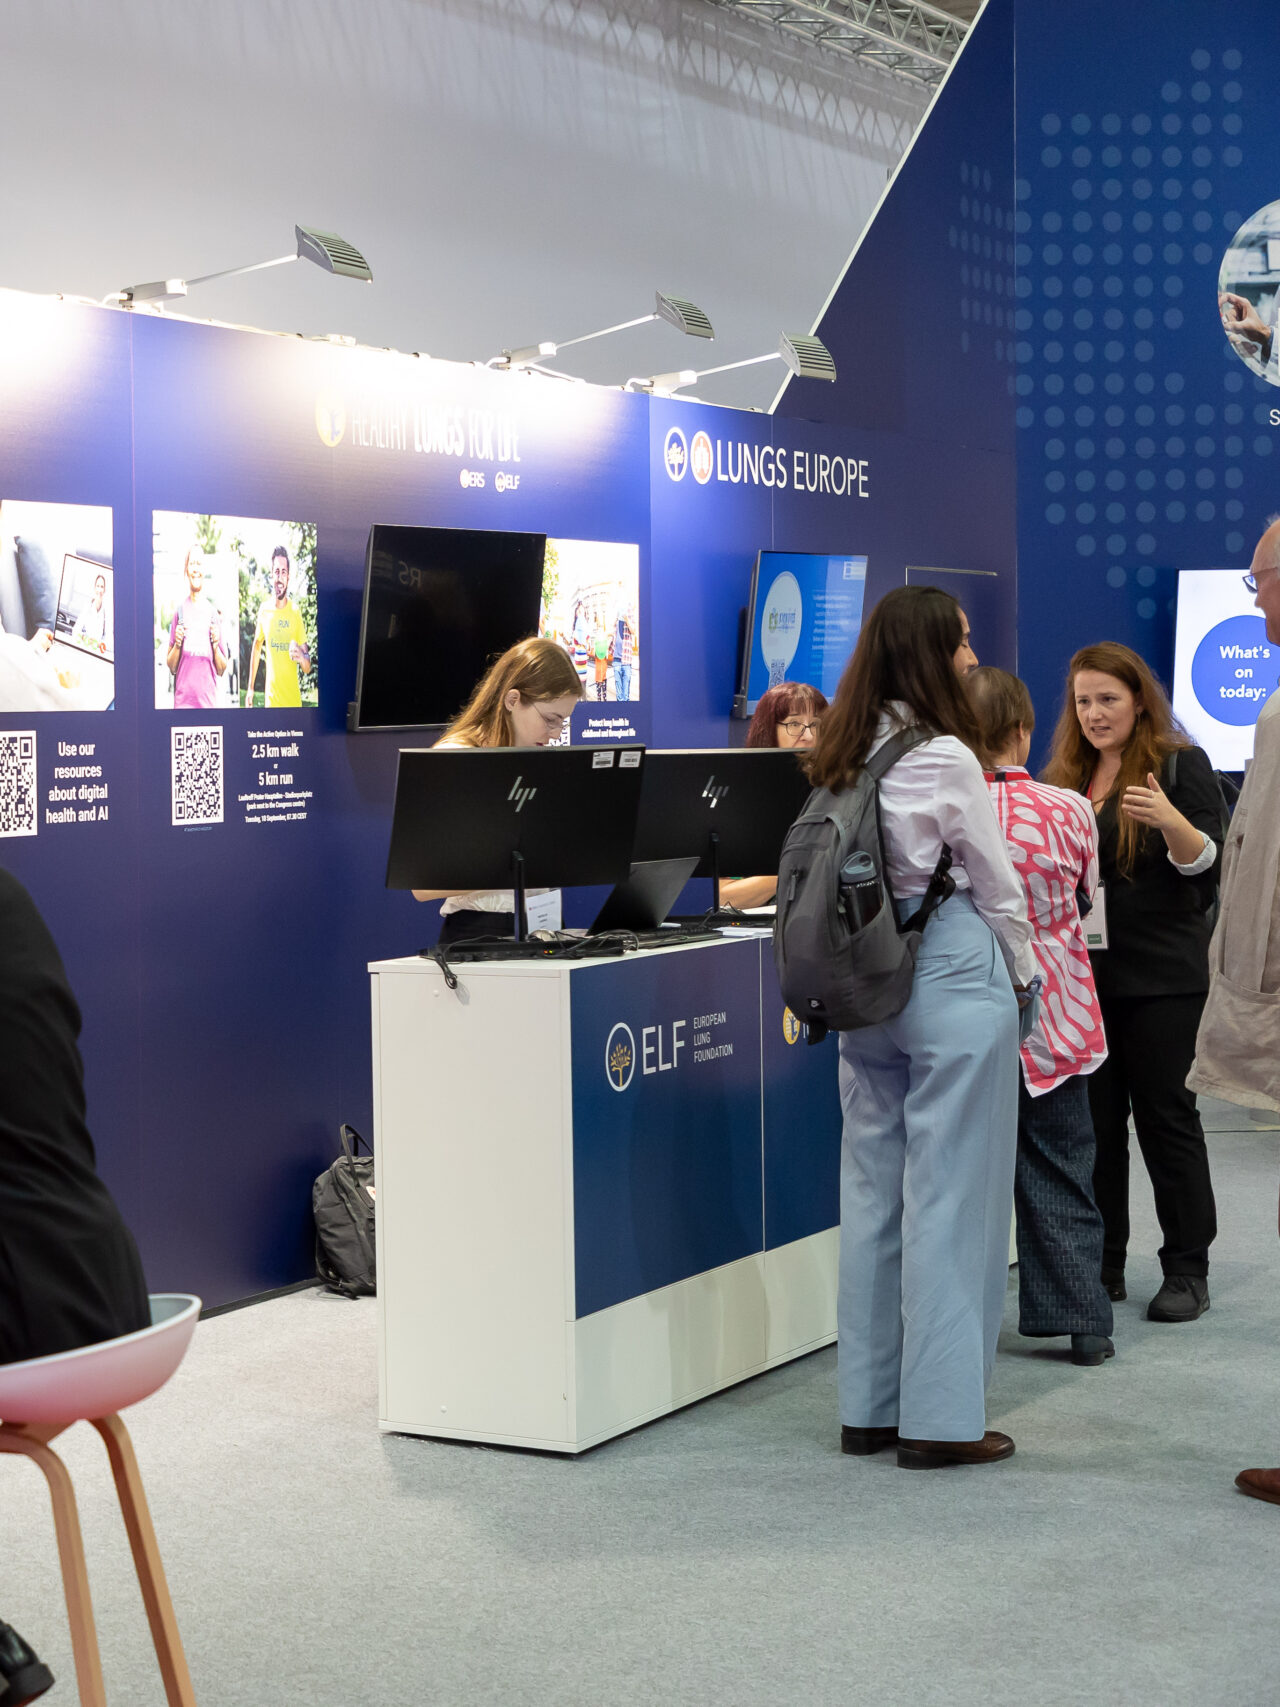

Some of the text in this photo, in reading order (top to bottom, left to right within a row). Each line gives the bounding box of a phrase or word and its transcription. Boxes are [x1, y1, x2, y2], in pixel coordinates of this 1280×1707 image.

[716, 439, 870, 498] LUNGS EUROPE
[469, 472, 486, 488] ERS
[505, 474, 521, 490] ELF
[1219, 645, 1270, 659] What's
[1234, 668, 1253, 679] on
[1219, 684, 1267, 702] today:
[58, 742, 96, 757] Use our
[251, 743, 299, 759] 2.5 km walk
[54, 765, 103, 779] resources
[258, 771, 294, 786] 5 km run
[48, 783, 108, 803] about digital
[46, 806, 109, 824] health and AI
[693, 1011, 726, 1029] EUROPEAN
[693, 1031, 710, 1046] LUNG
[642, 1019, 686, 1075] ELF
[693, 1043, 733, 1063] FOUNDATION
